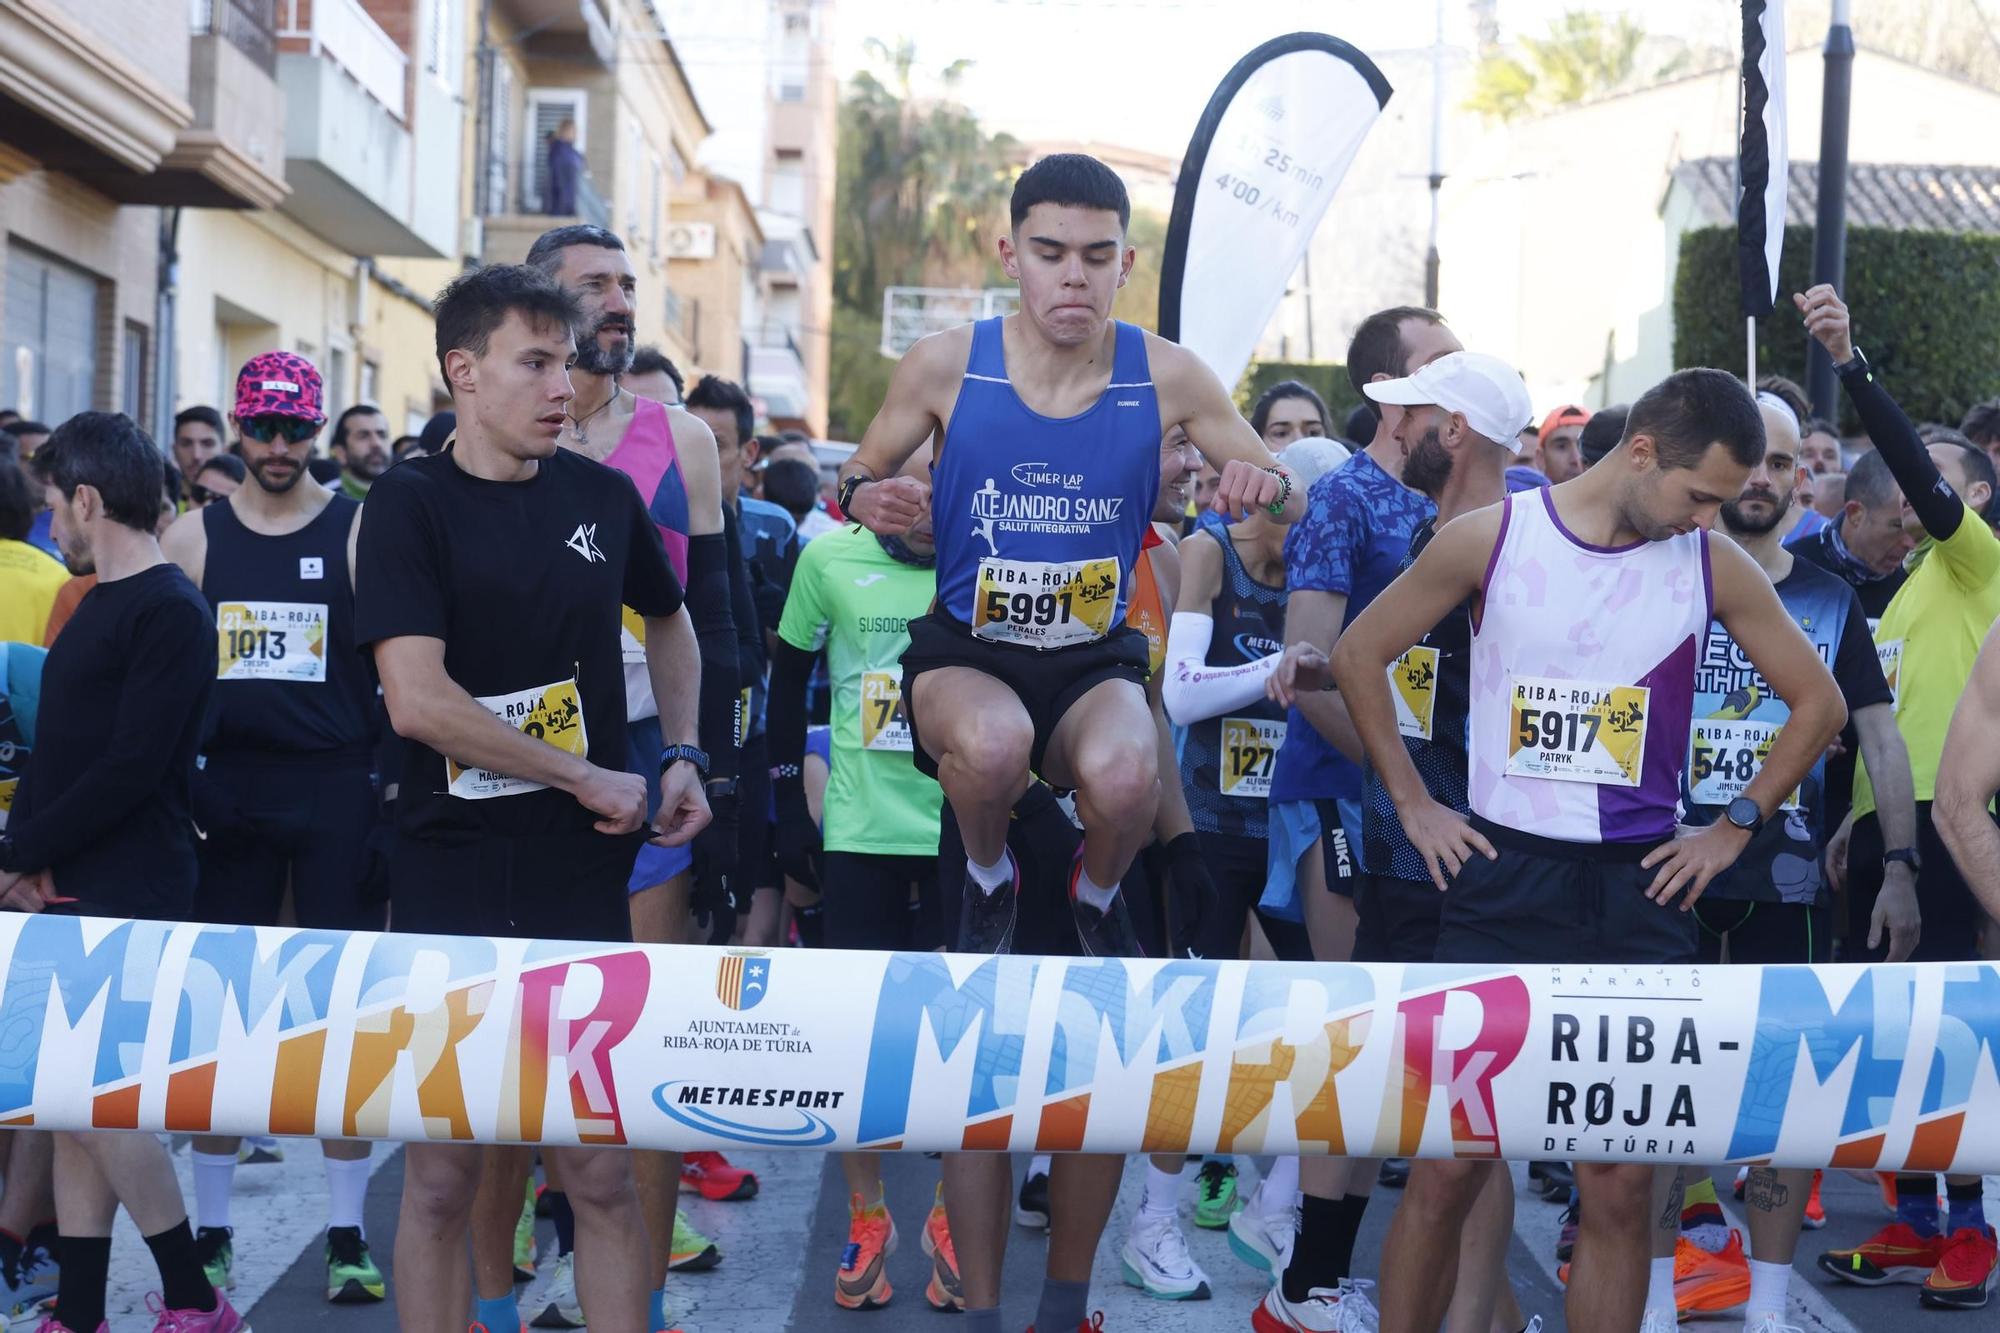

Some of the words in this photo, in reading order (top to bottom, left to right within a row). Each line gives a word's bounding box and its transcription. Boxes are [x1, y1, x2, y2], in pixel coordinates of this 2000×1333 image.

[1025, 472, 1060, 484] TIMER
[1063, 474, 1084, 485] LAP
[971, 492, 1070, 521] ALEJANDRO
[1074, 497, 1124, 522] SANZ
[998, 522, 1029, 533] SALUT
[1031, 522, 1091, 534] INTEGRATIVA
[986, 591, 1073, 625] 5991
[1007, 624, 1047, 636] PERALES
[228, 629, 287, 660] 1013
[243, 660, 269, 668] CRESPO
[866, 681, 886, 699] 21
[734, 699, 742, 748] KIPRUN
[873, 699, 907, 730] 74
[1228, 728, 1247, 746] 21
[1249, 728, 1284, 739] RIBA-
[1519, 708, 1602, 753] 5917
[1230, 746, 1277, 778] 127
[1540, 751, 1572, 764] PATRYK
[1245, 777, 1272, 785] ALFONS
[1716, 782, 1747, 792] JIMENE
[1331, 828, 1352, 878] NIKE
[1551, 976, 1700, 988] MARATÓ
[688, 1020, 790, 1036] AJUNTAMENT
[791, 1027, 801, 1037] de
[663, 1036, 739, 1053] RIBA-ROJA
[742, 1039, 762, 1051] DE
[765, 1037, 813, 1053] TÚRIA
[1552, 1013, 1739, 1065] RIBA-
[678, 1086, 844, 1109] METAESPORT
[1544, 1137, 1577, 1151] DE
[1603, 1135, 1695, 1154] TÚRIA
